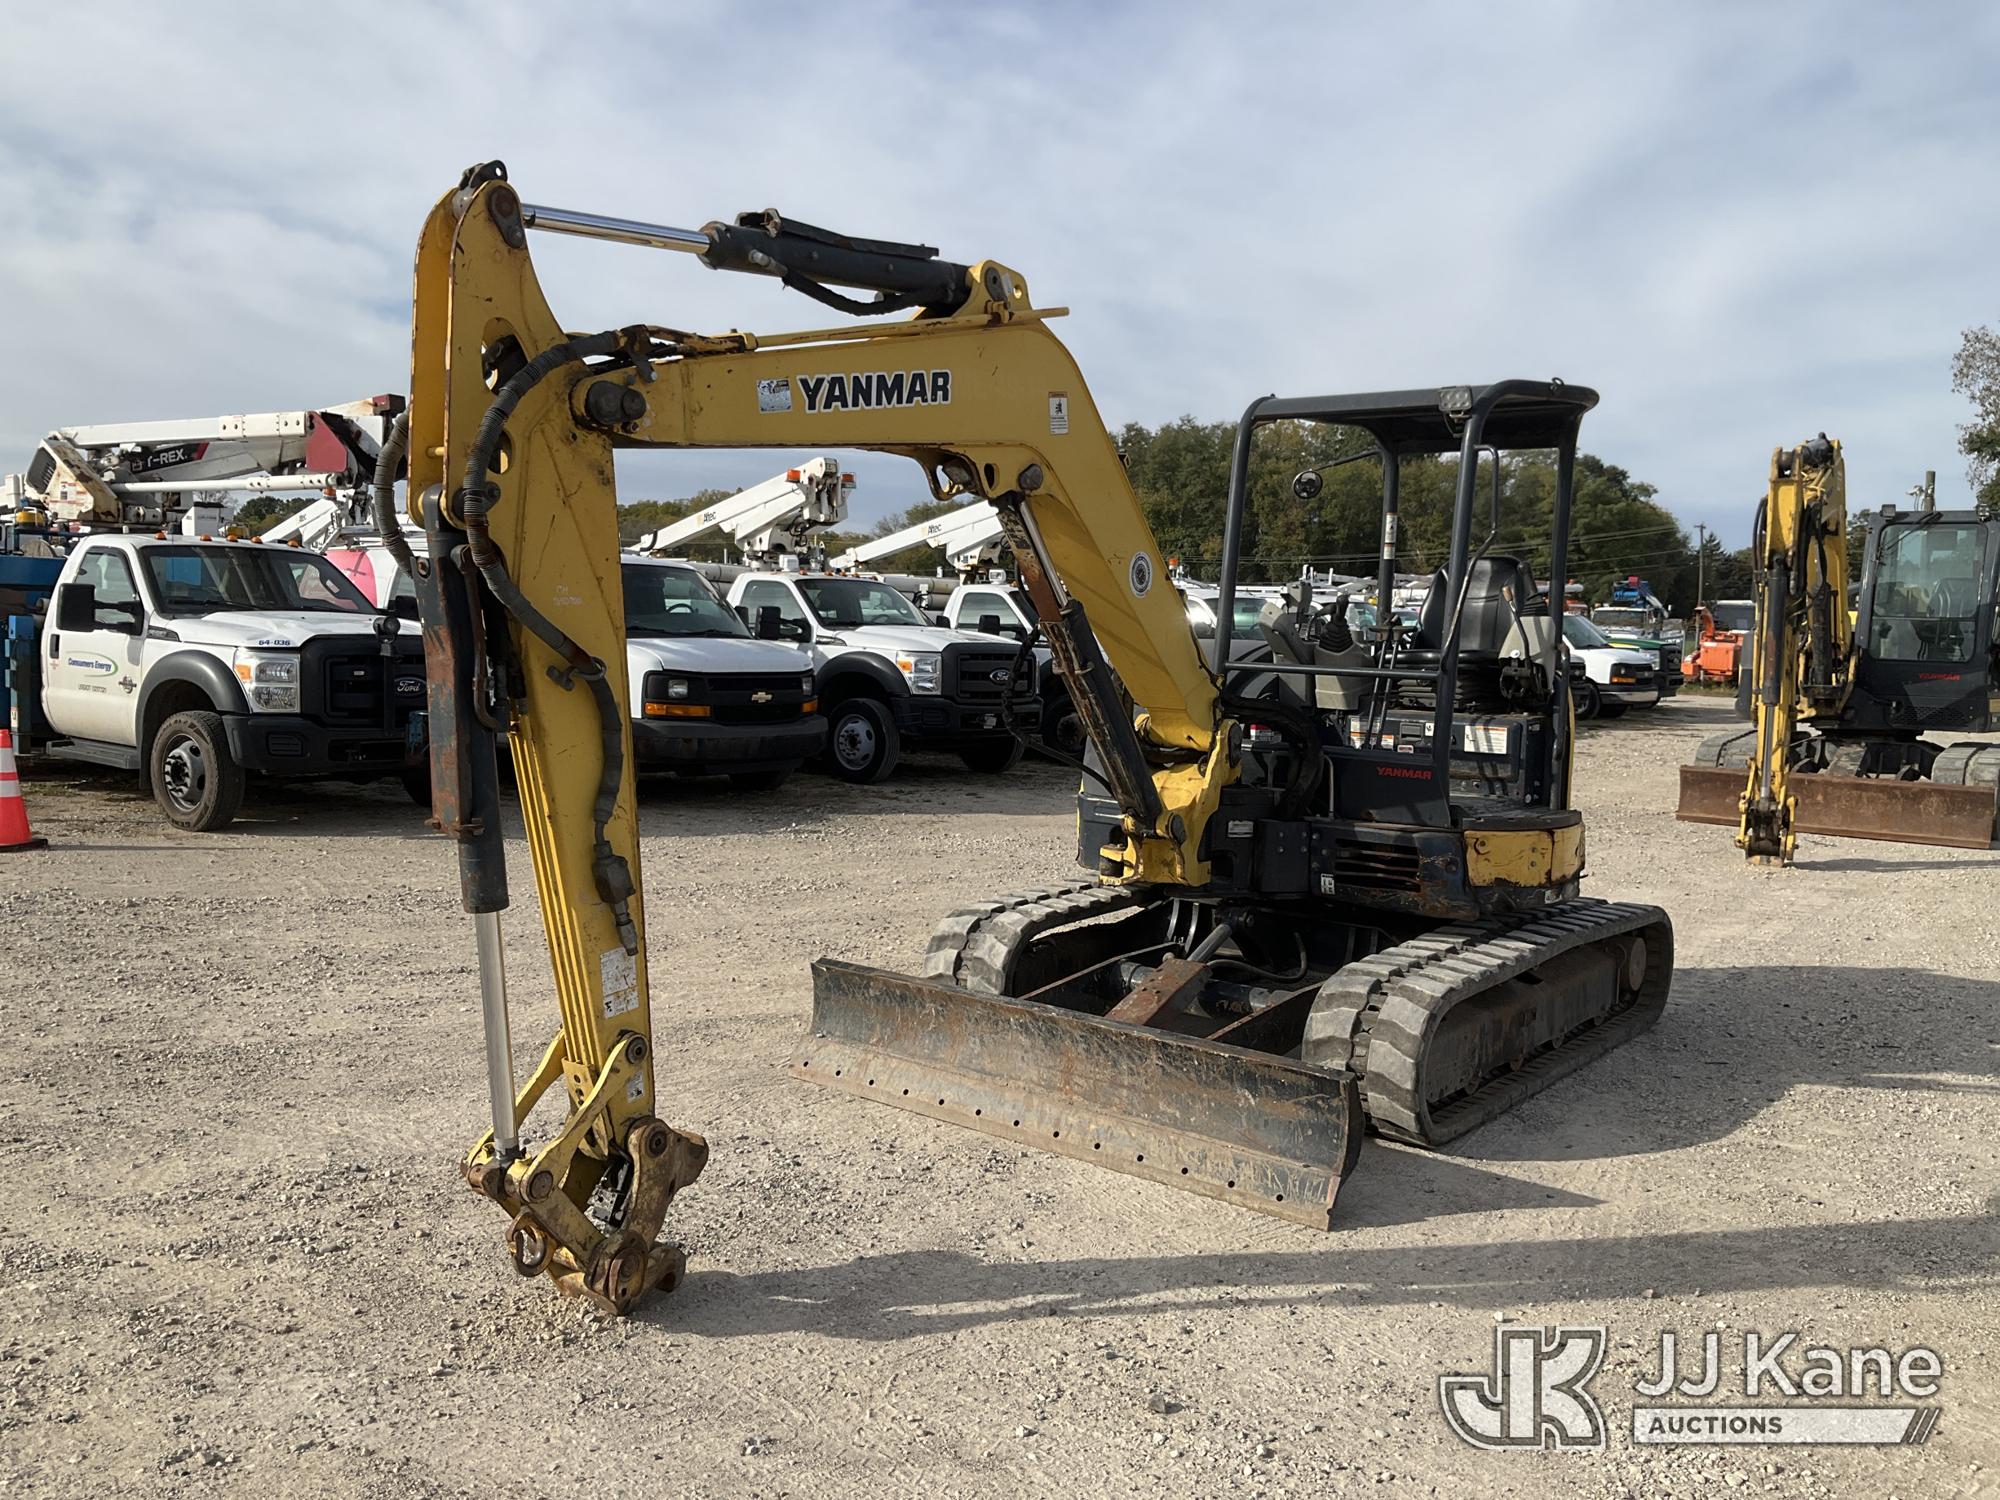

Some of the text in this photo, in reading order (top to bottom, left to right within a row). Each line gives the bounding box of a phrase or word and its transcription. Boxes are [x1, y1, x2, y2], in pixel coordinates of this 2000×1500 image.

[798, 371, 950, 411] YANMAR
[94, 661, 112, 672] Energy
[397, 680, 421, 692] Ford
[1376, 766, 1432, 780] YANMAR
